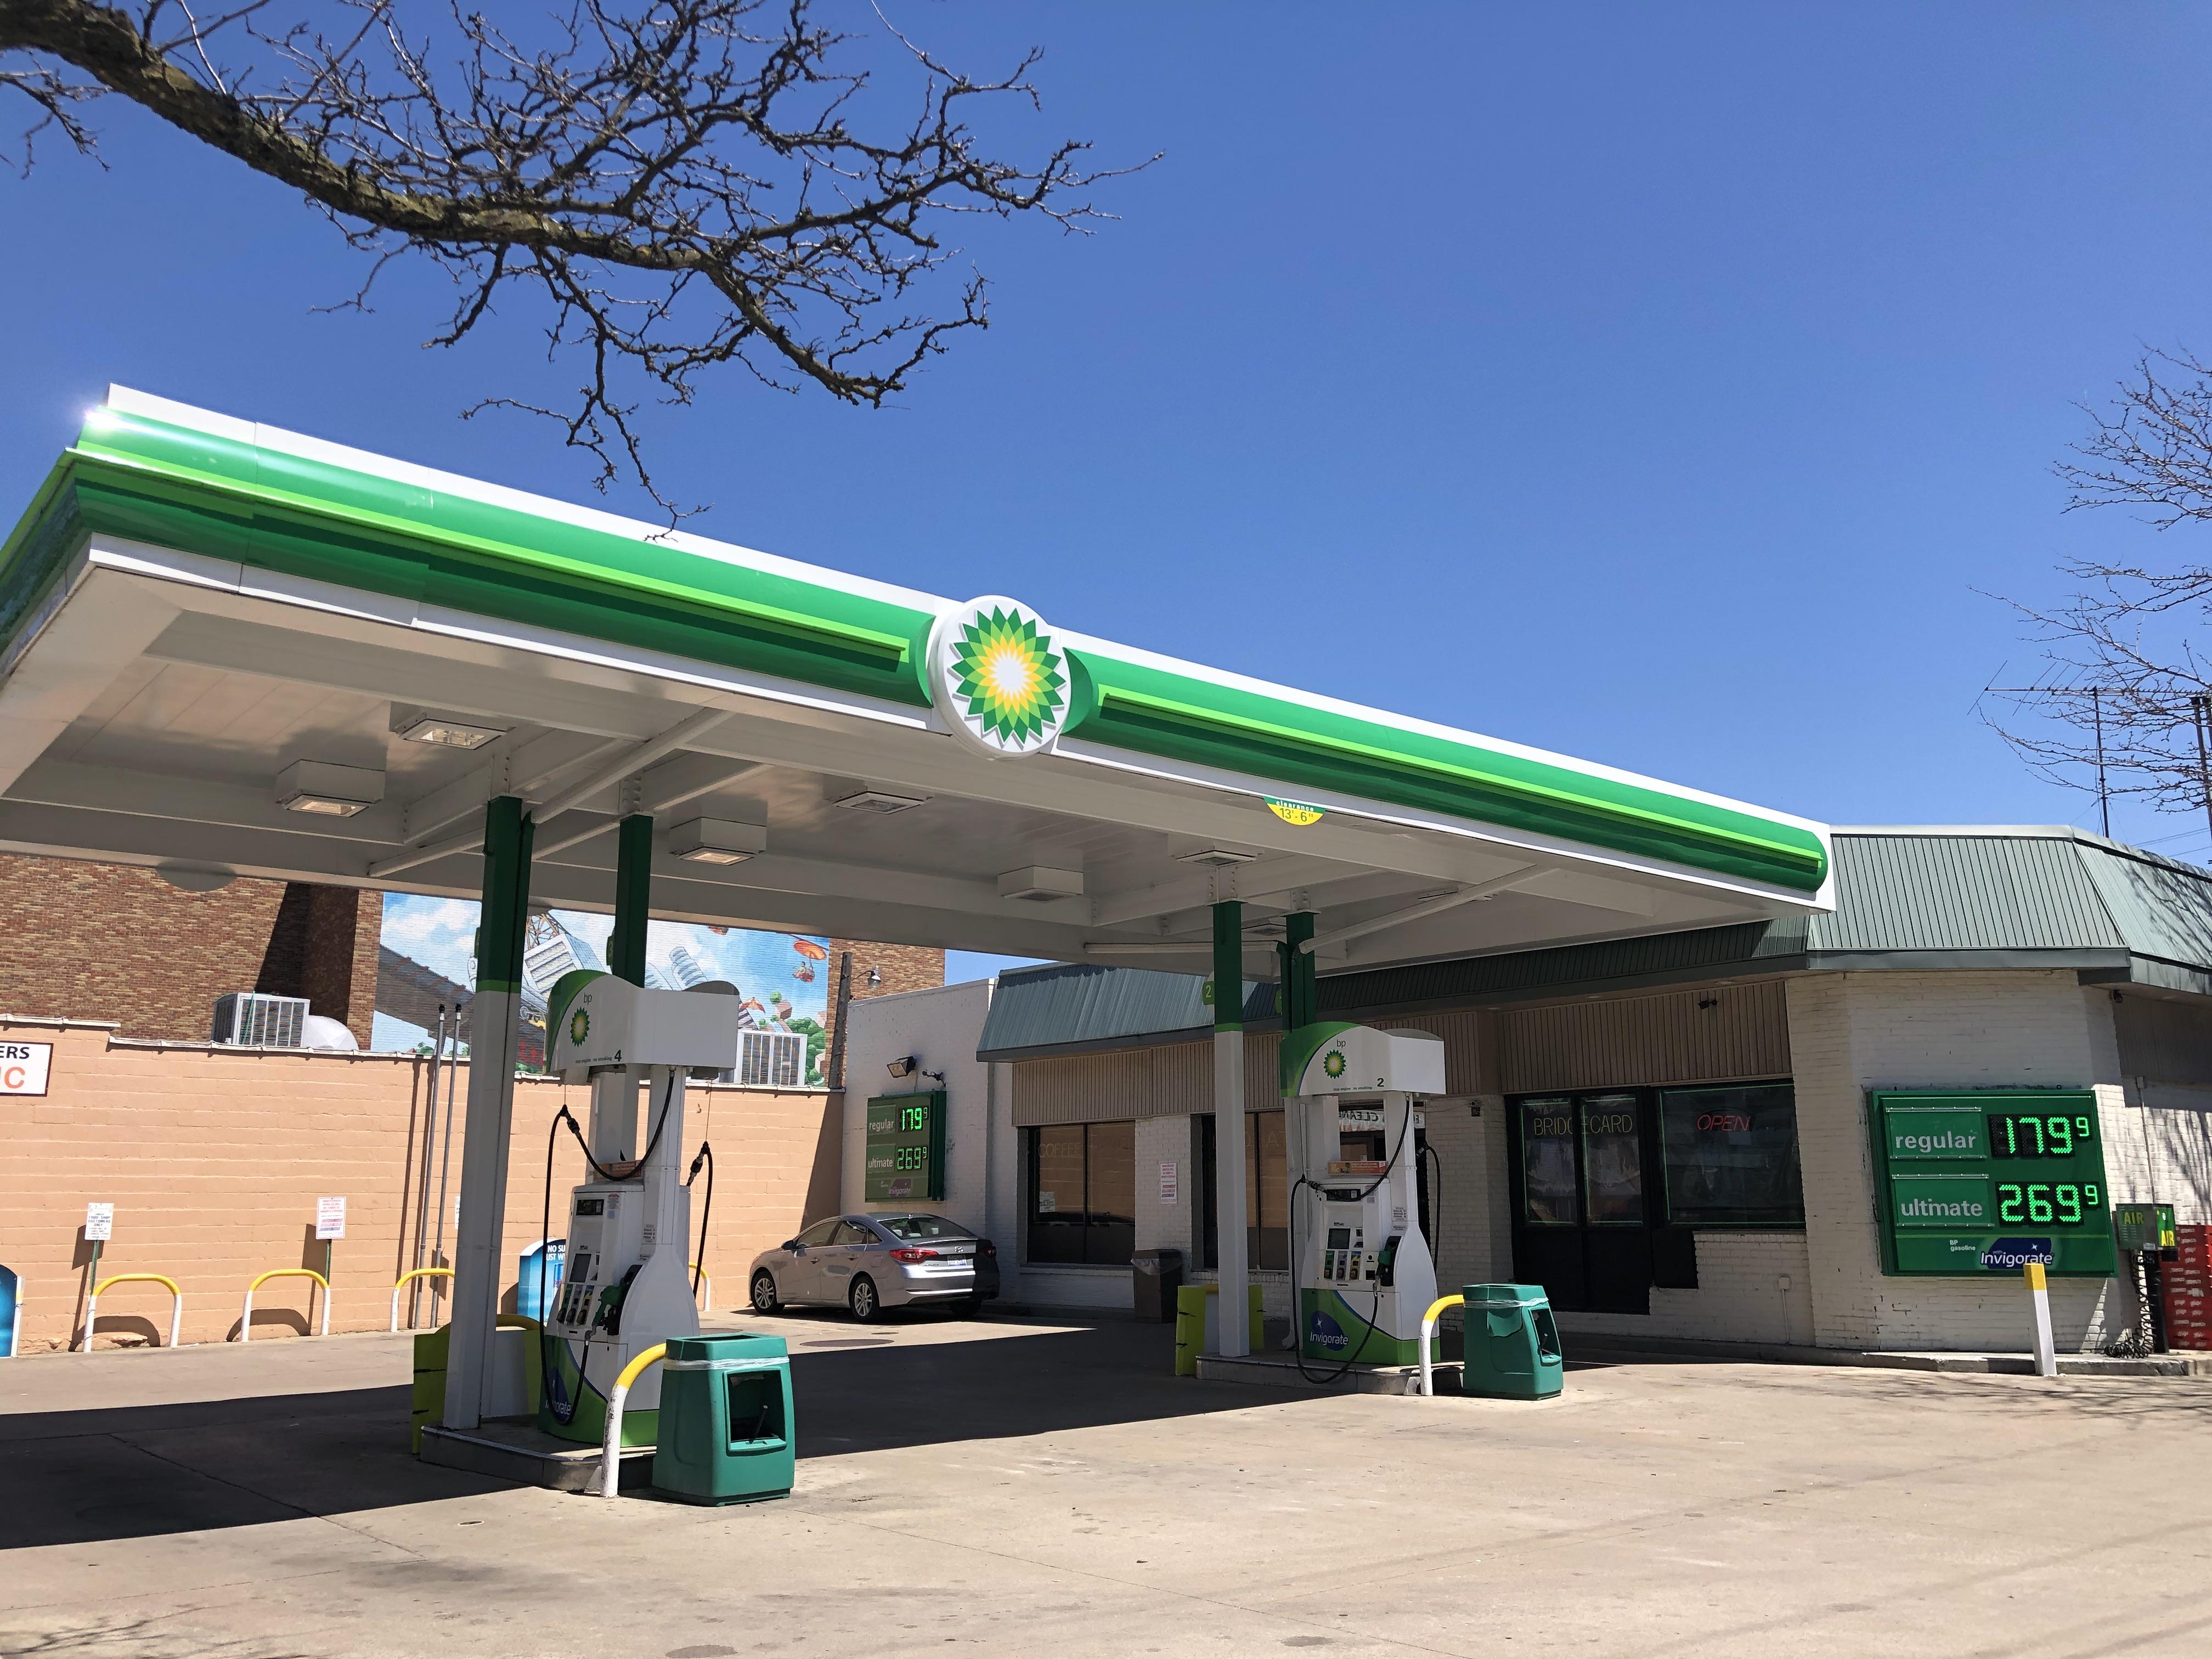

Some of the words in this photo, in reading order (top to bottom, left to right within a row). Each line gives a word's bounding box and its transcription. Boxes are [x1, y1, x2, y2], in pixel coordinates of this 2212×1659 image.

[1276, 800, 1314, 812] clearance
[583, 992, 592, 1005] bp
[1205, 985, 1211, 998] 2
[1336, 1039, 1346, 1048] bp
[614, 1049, 622, 1062] 4
[0, 1066, 25, 1088] C
[1377, 1077, 1385, 1087] 2
[868, 1118, 894, 1132] regular
[1697, 1114, 1751, 1131] OPEN
[1894, 1131, 1976, 1153] regular
[1038, 1142, 1082, 1158] COFFEE
[868, 1157, 893, 1168] ultimate
[1900, 1199, 1983, 1217] ultimate
[2124, 1211, 2144, 1224] AIR
[2161, 1229, 2175, 1246] AIR
[1981, 1252, 2053, 1267] Invigorate
[1310, 1331, 1348, 1345] Invigorate
